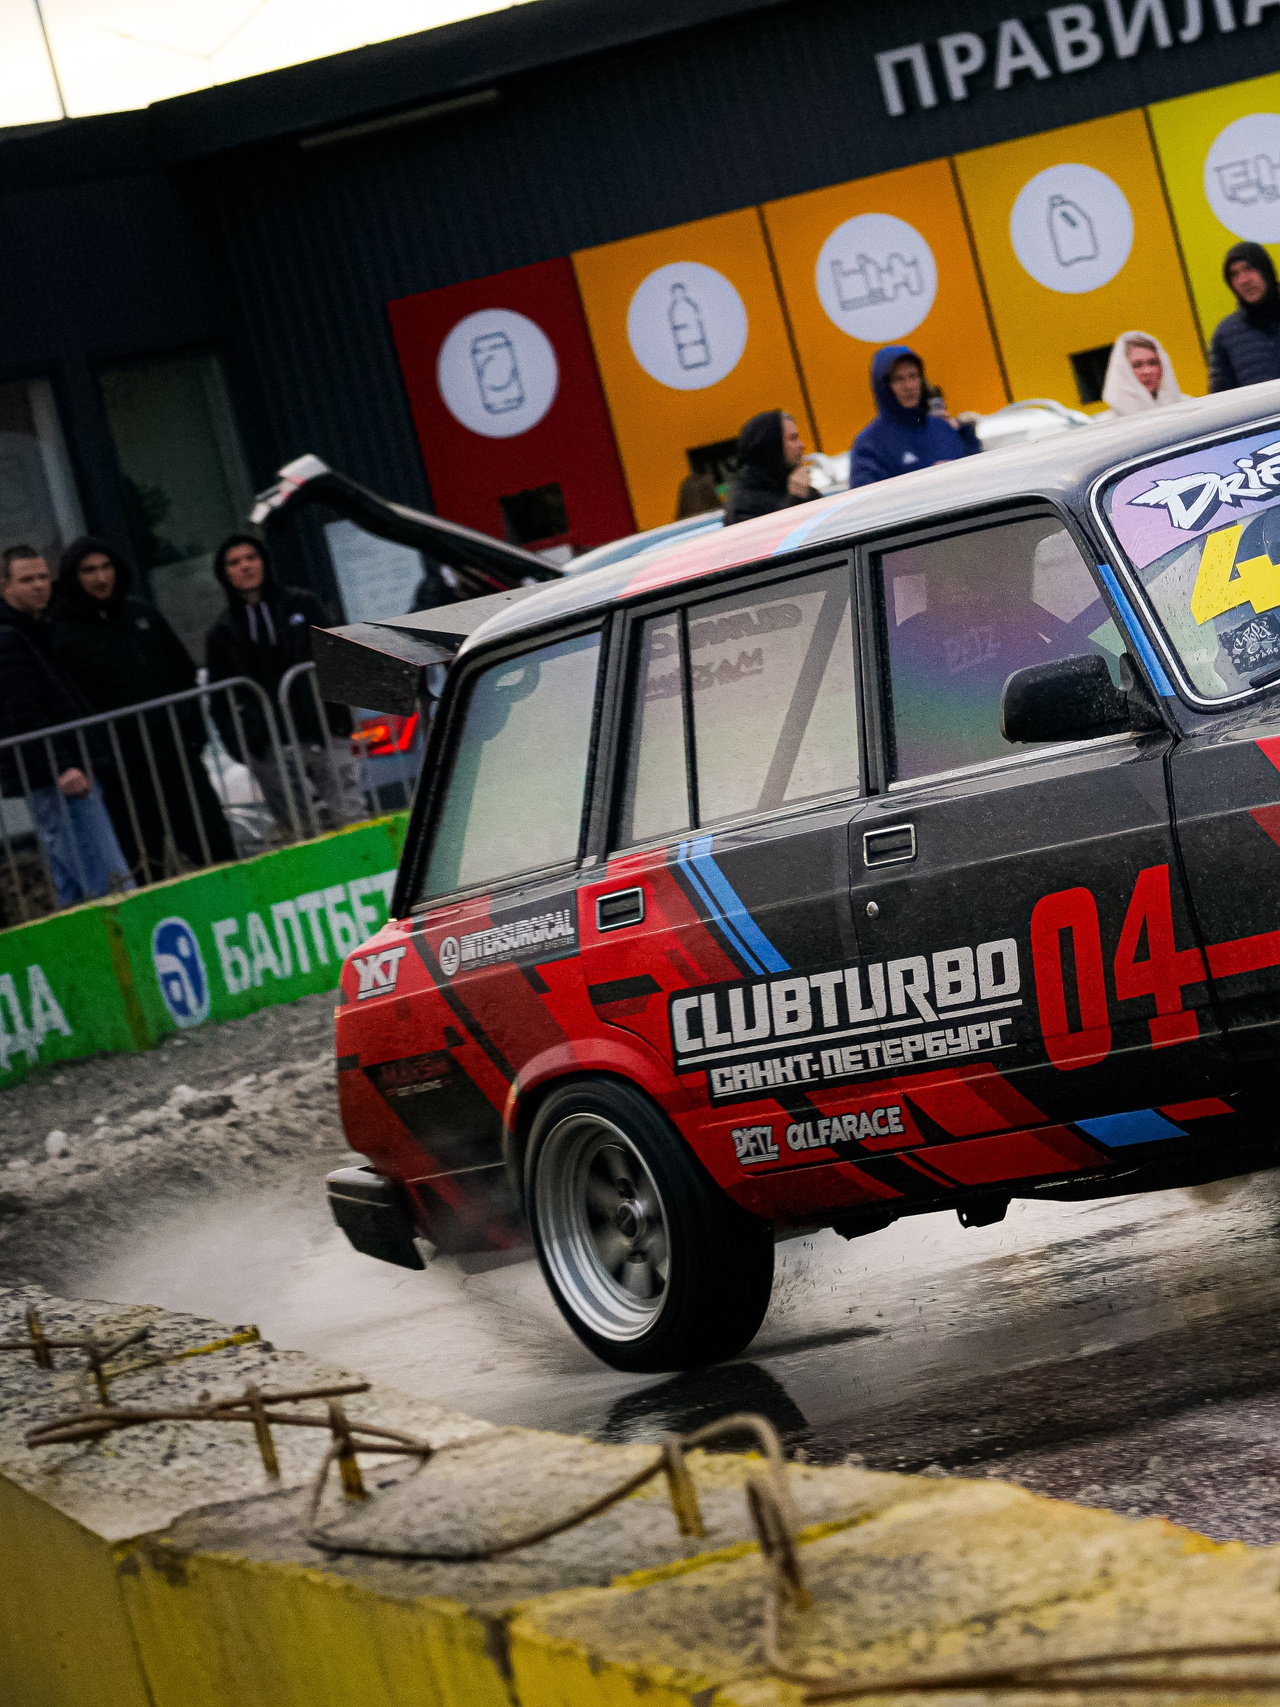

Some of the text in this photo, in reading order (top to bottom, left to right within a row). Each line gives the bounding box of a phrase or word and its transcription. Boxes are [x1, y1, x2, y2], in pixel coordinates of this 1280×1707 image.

[671, 937, 1022, 1053] CLUBTURBO
[1030, 863, 1206, 1071] 04
[712, 1019, 1014, 1095] САНКТ-ПЕТЕРБУРГ
